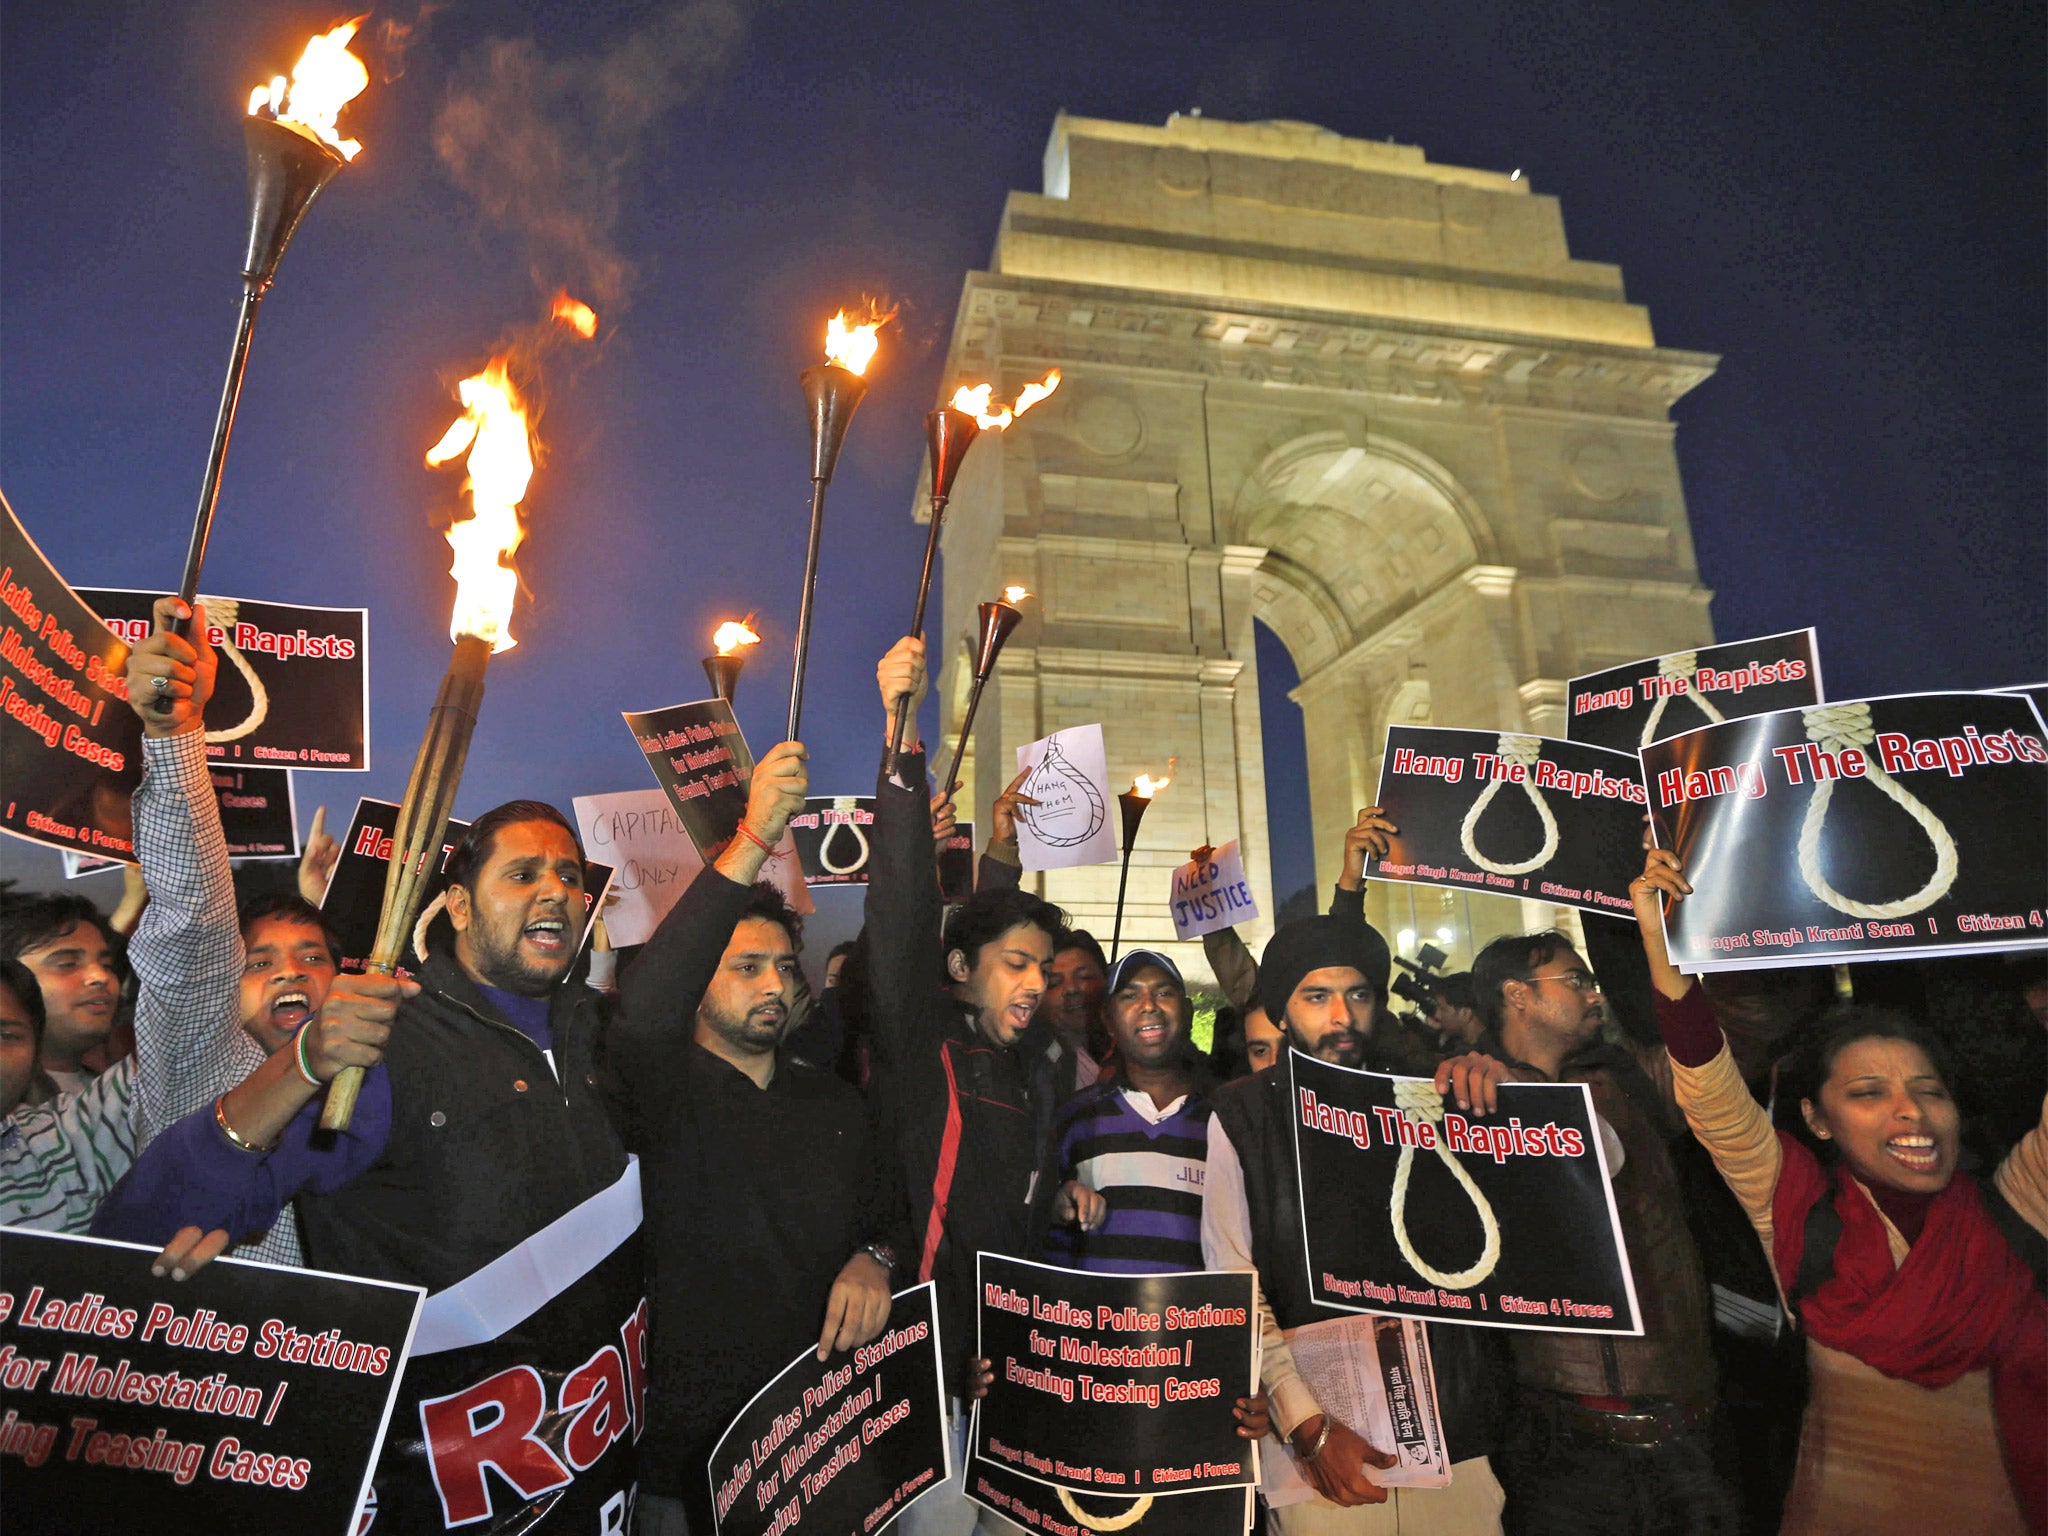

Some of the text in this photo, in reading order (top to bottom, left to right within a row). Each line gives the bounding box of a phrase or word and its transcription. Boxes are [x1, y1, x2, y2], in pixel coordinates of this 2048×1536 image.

[0, 566, 43, 632] Ladies
[39, 613, 86, 671] Police
[104, 618, 150, 645] ng
[235, 622, 356, 661] Rapists
[0, 626, 92, 719] Molestation
[1575, 658, 1808, 716] Hang The Rapists
[0, 675, 125, 772] Teasing Cases
[253, 746, 297, 760] Citizen
[299, 749, 308, 760] 4
[310, 749, 350, 763] Forces
[1393, 747, 1647, 805] Hang The Rapists
[1657, 725, 2048, 808] Hang The Rapists
[1036, 781, 1067, 794] HANG
[1039, 794, 1073, 811] THEM
[26, 810, 76, 839] Citizen
[78, 827, 90, 842] 4
[92, 829, 134, 852] Force
[592, 808, 686, 846] CAPITAL
[821, 809, 850, 825] The
[1177, 862, 1219, 895] NEED
[1379, 861, 1415, 875] Bhagat
[1417, 864, 1447, 879] Singh
[1449, 868, 1484, 883] Kranti
[1486, 873, 1515, 888] Sena
[1541, 881, 1581, 899] Citizen
[1583, 889, 1593, 901] 4
[1594, 891, 1633, 910] Forces
[1175, 881, 1252, 927] JUSTICE
[1753, 926, 1802, 949] Singh
[1806, 923, 1864, 943] Kranti
[1866, 919, 1914, 938] Sena
[1957, 911, 2025, 932] Citizen
[2029, 910, 2043, 927] 4
[1299, 1086, 1586, 1165] Hang The Rapists
[986, 1282, 1246, 1331] Make Ladies Police Stations
[1322, 1272, 1361, 1298] Bhagat
[1363, 1280, 1396, 1304] Singh
[1397, 1284, 1436, 1307] Kranti
[1438, 1289, 1471, 1309] Sena
[1500, 1294, 1548, 1315] Citizen
[1550, 1299, 1561, 1316] 4
[1562, 1299, 1613, 1318] Forces
[18, 1286, 138, 1339] Ladies
[141, 1302, 248, 1355] Police
[254, 1319, 392, 1376] Stations
[1030, 1330, 1056, 1355] for
[1061, 1336, 1180, 1367] Molestation
[0, 1346, 49, 1391] for
[51, 1352, 262, 1420] Molestation
[1006, 1357, 1220, 1408] Evening Teasing Cases
[715, 1321, 928, 1524] Make Ladies Police Stations
[66, 1417, 206, 1485] Teasing
[209, 1436, 312, 1491] Cases
[757, 1471, 779, 1512] for
[780, 1386, 872, 1484] Molestation
[800, 1435, 861, 1505] Teasing
[862, 1398, 910, 1446] Cases
[989, 1438, 1022, 1463] Bhagat
[1023, 1450, 1053, 1474] Singh
[1055, 1461, 1092, 1482] Kranti
[1094, 1469, 1126, 1484] Sena
[1152, 1467, 1192, 1484] Citizen
[1193, 1463, 1202, 1478] 4
[1203, 1462, 1241, 1477] Forces
[901, 1467, 934, 1497] Forces
[977, 1478, 1079, 1536] Bhagat Singh Kranti
